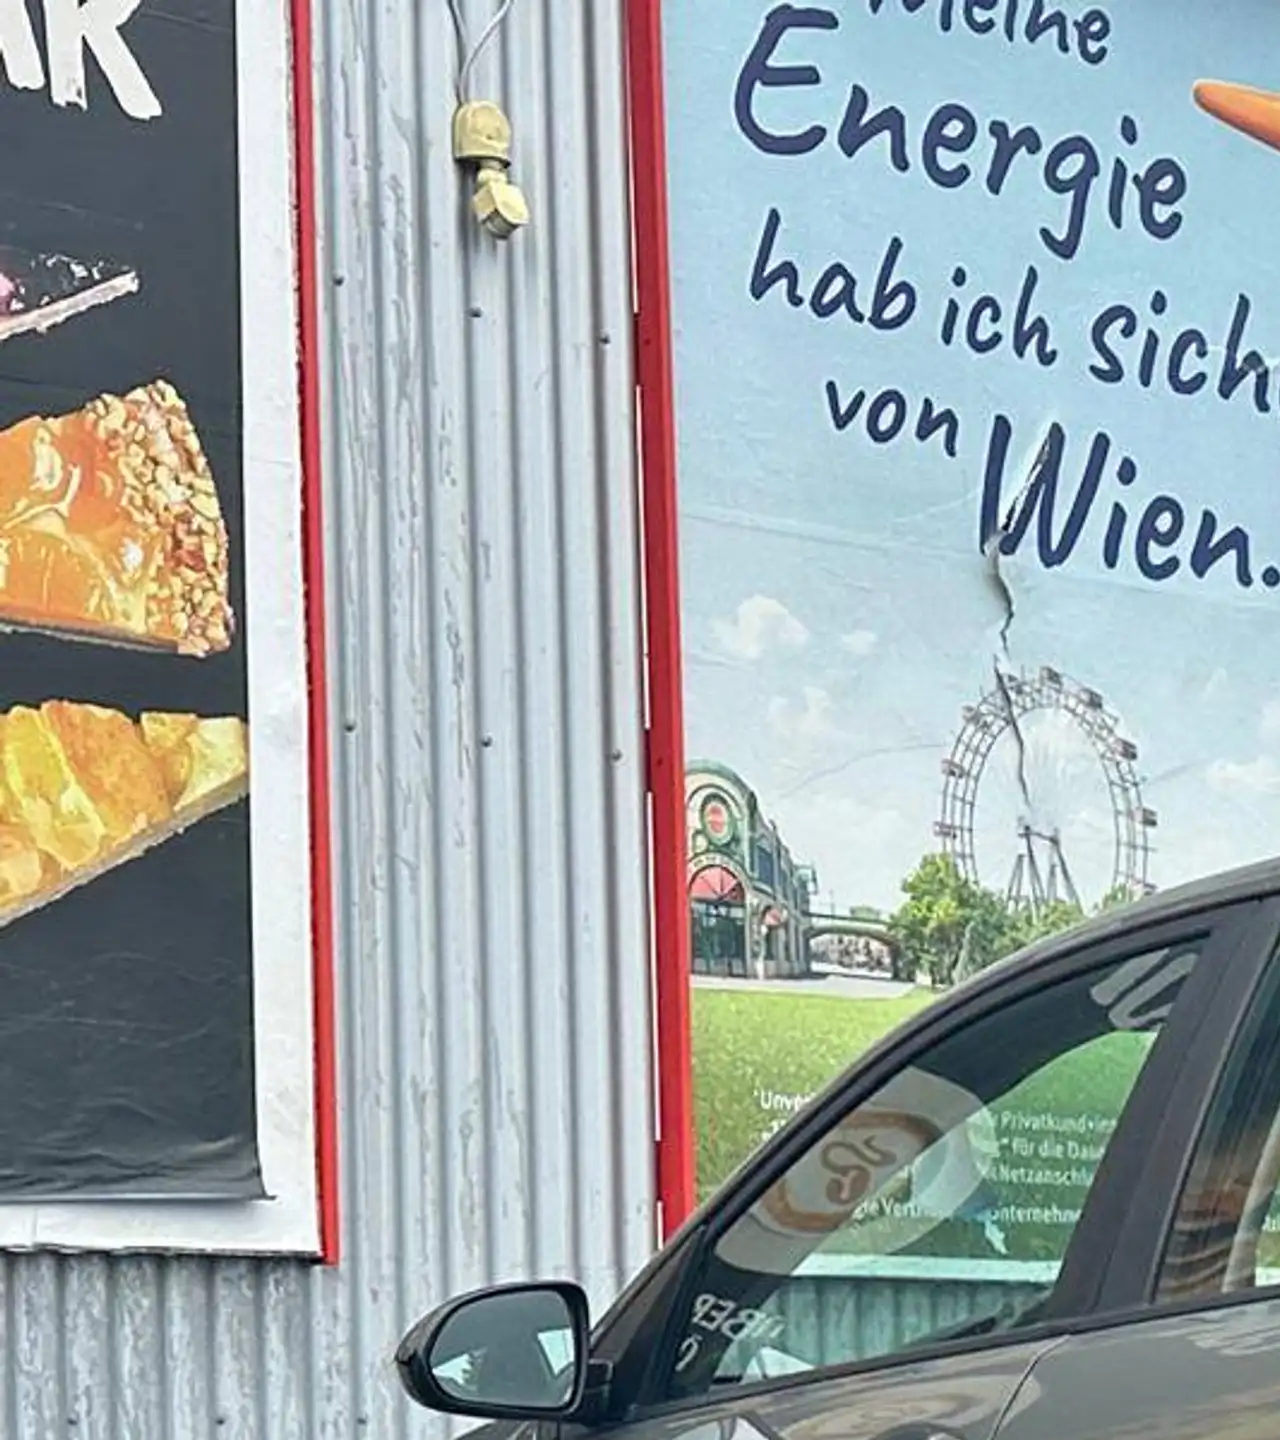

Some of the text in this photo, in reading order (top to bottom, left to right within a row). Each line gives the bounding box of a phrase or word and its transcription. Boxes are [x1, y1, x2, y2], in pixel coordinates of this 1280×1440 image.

[733, 3, 1187, 259] Energie
[749, 207, 917, 330] hab
[941, 265, 1058, 366] ich
[826, 379, 959, 457] von
